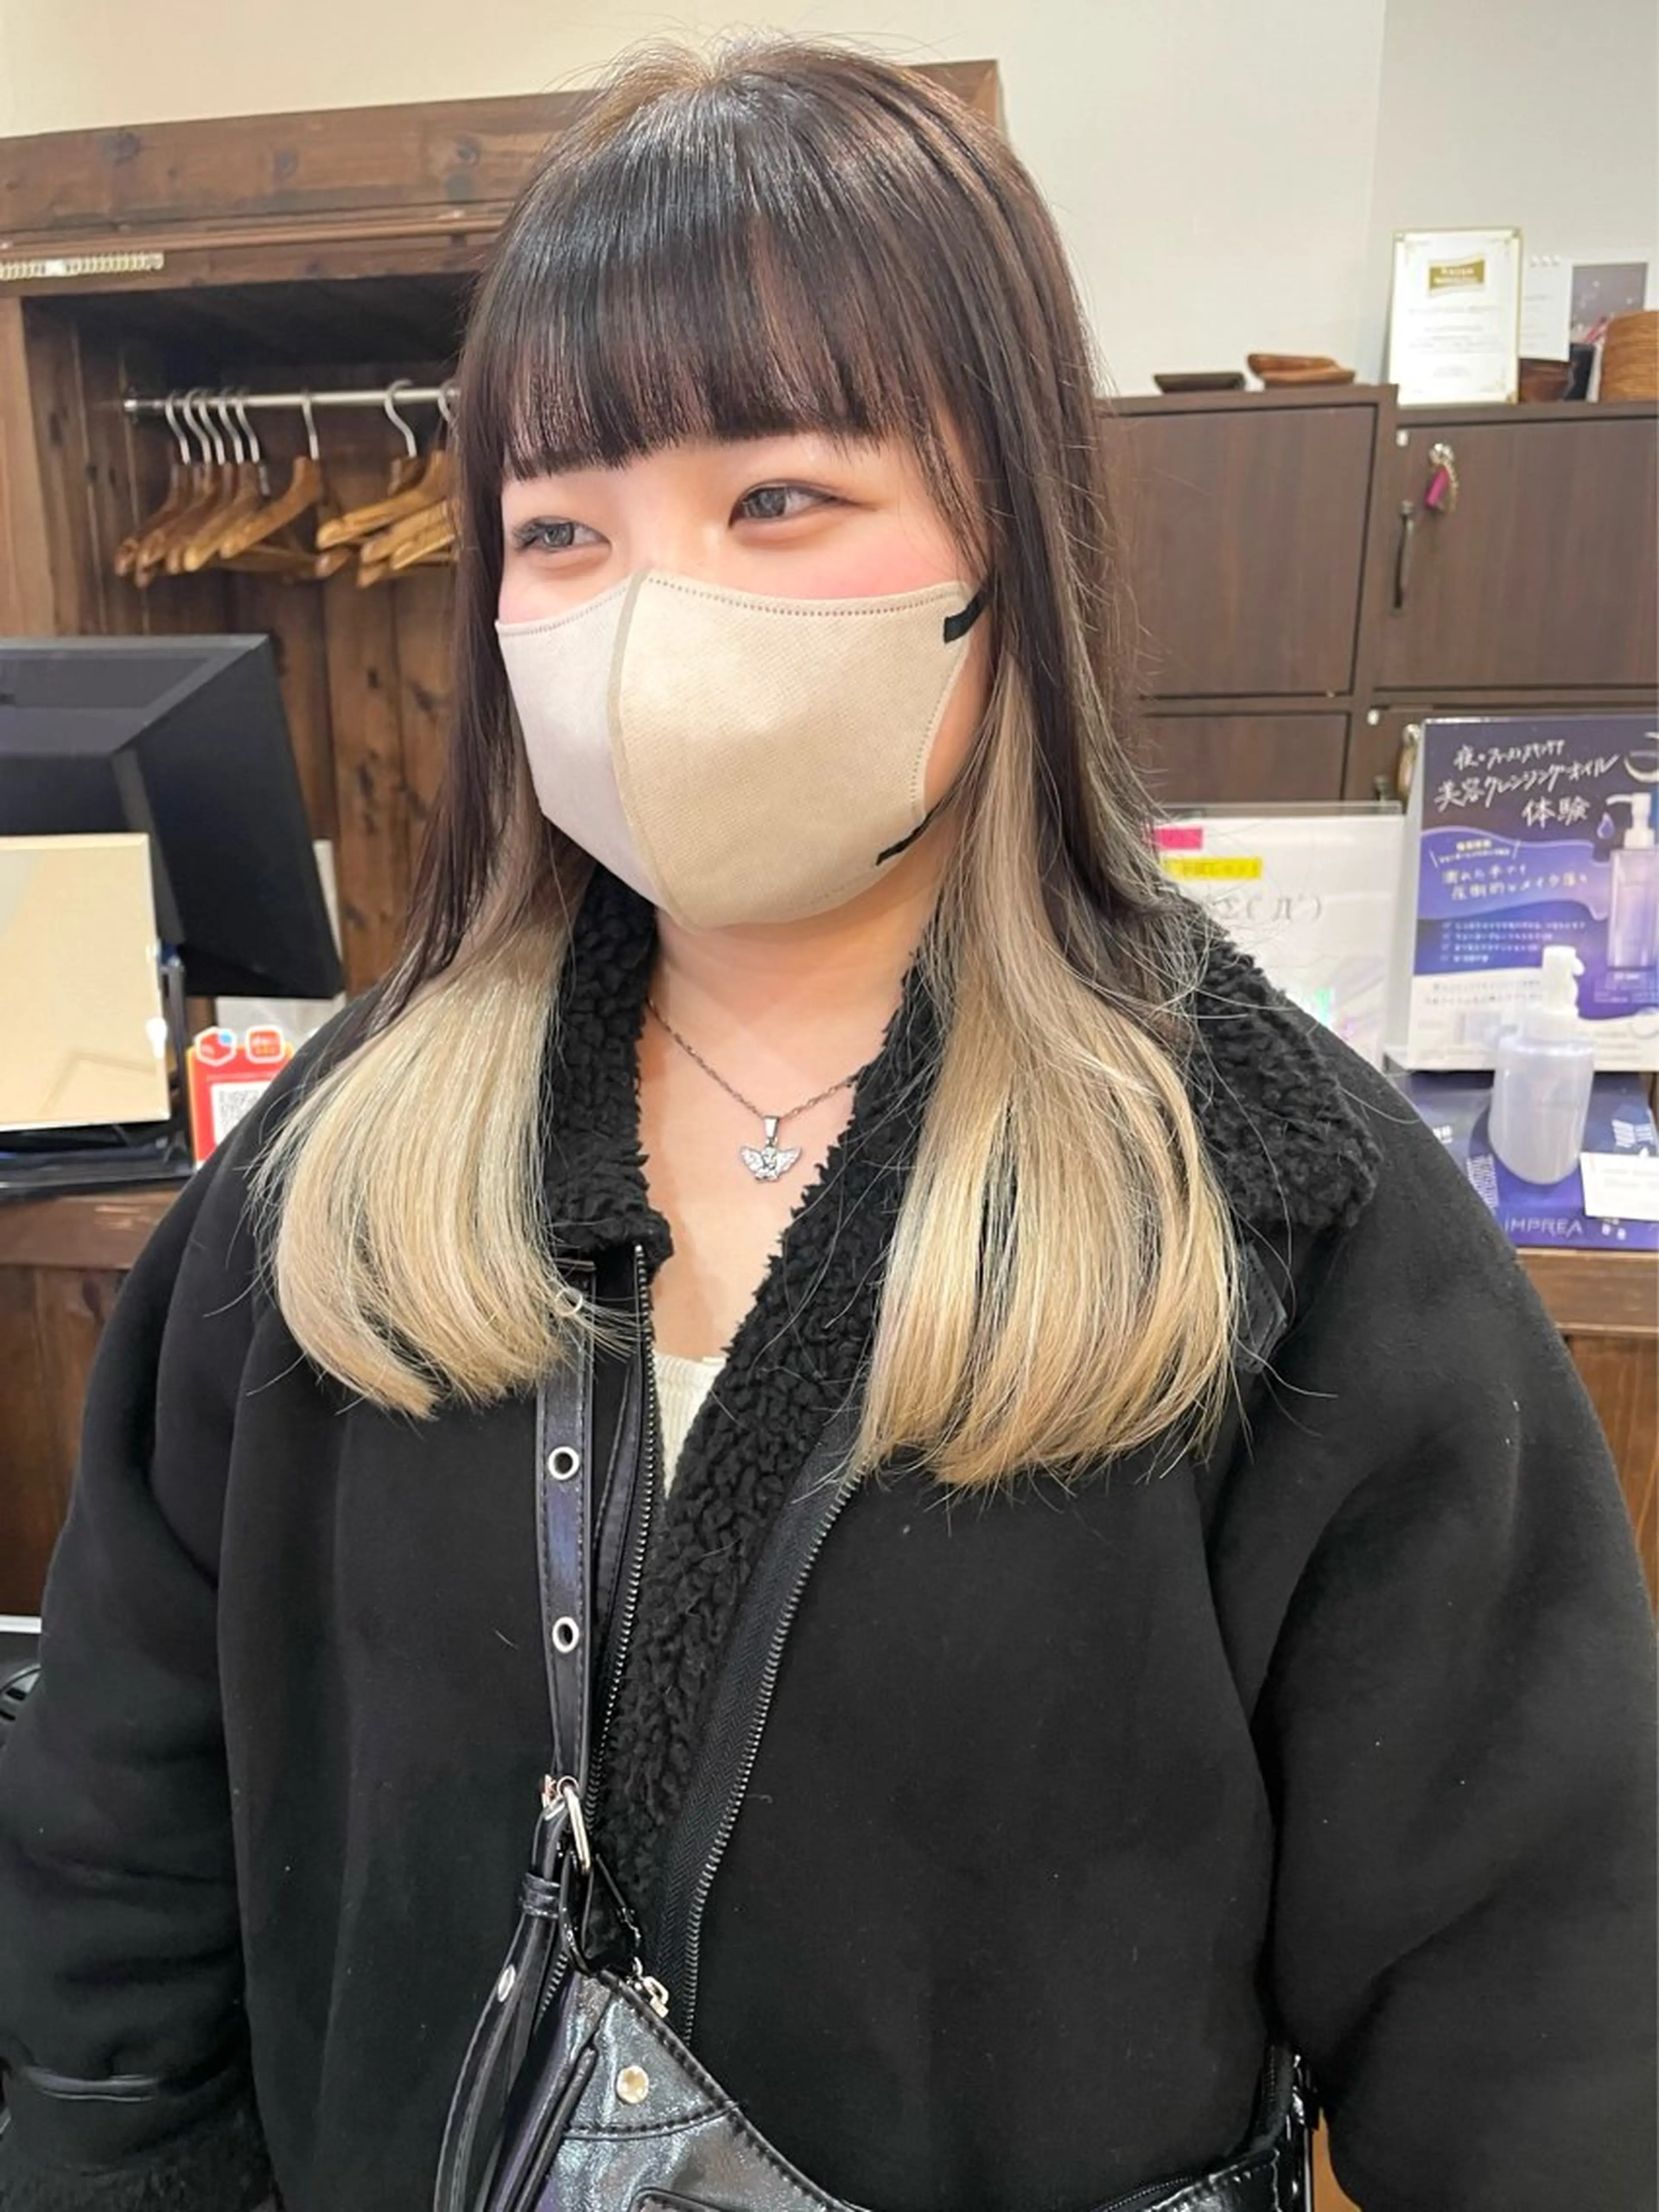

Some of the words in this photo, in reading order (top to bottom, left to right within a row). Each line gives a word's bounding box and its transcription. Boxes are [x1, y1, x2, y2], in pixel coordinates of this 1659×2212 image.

[1434, 754, 1619, 812] 美容クレンジングオイル
[1522, 796, 1591, 829] 体験
